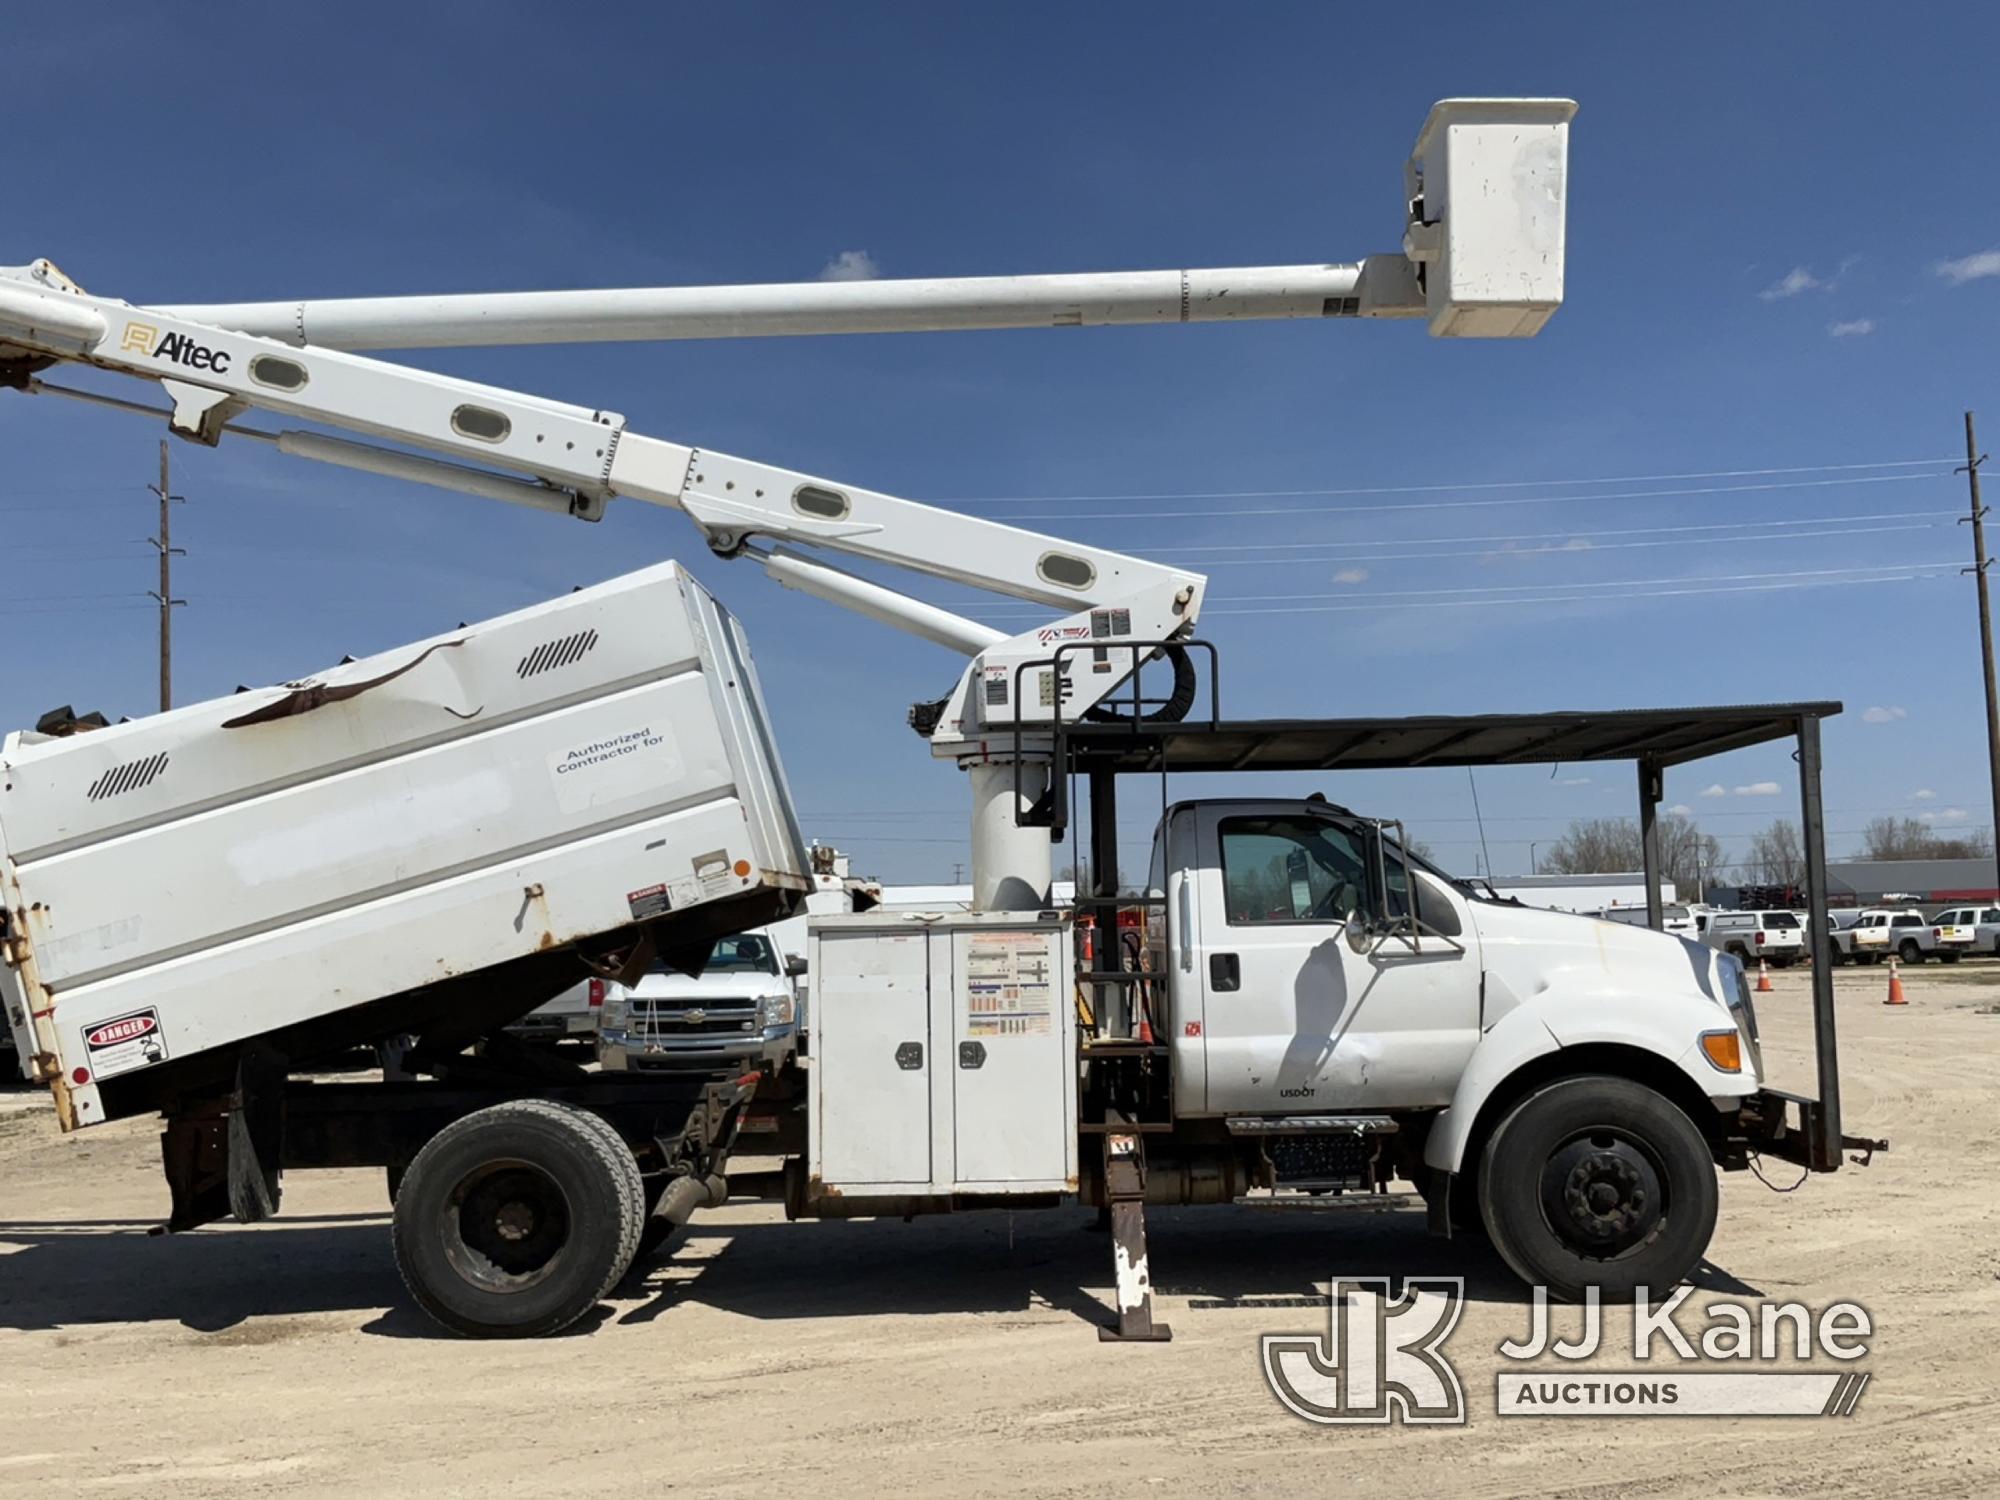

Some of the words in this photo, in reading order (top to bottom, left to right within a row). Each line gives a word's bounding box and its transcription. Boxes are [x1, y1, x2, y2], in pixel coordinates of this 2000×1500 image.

[152, 332, 231, 374] Altec
[556, 743, 638, 774] Contractor
[643, 735, 664, 747] for
[567, 727, 651, 760] Authorized
[98, 1020, 145, 1042] DANGER
[1280, 1088, 1315, 1098] USDOT
